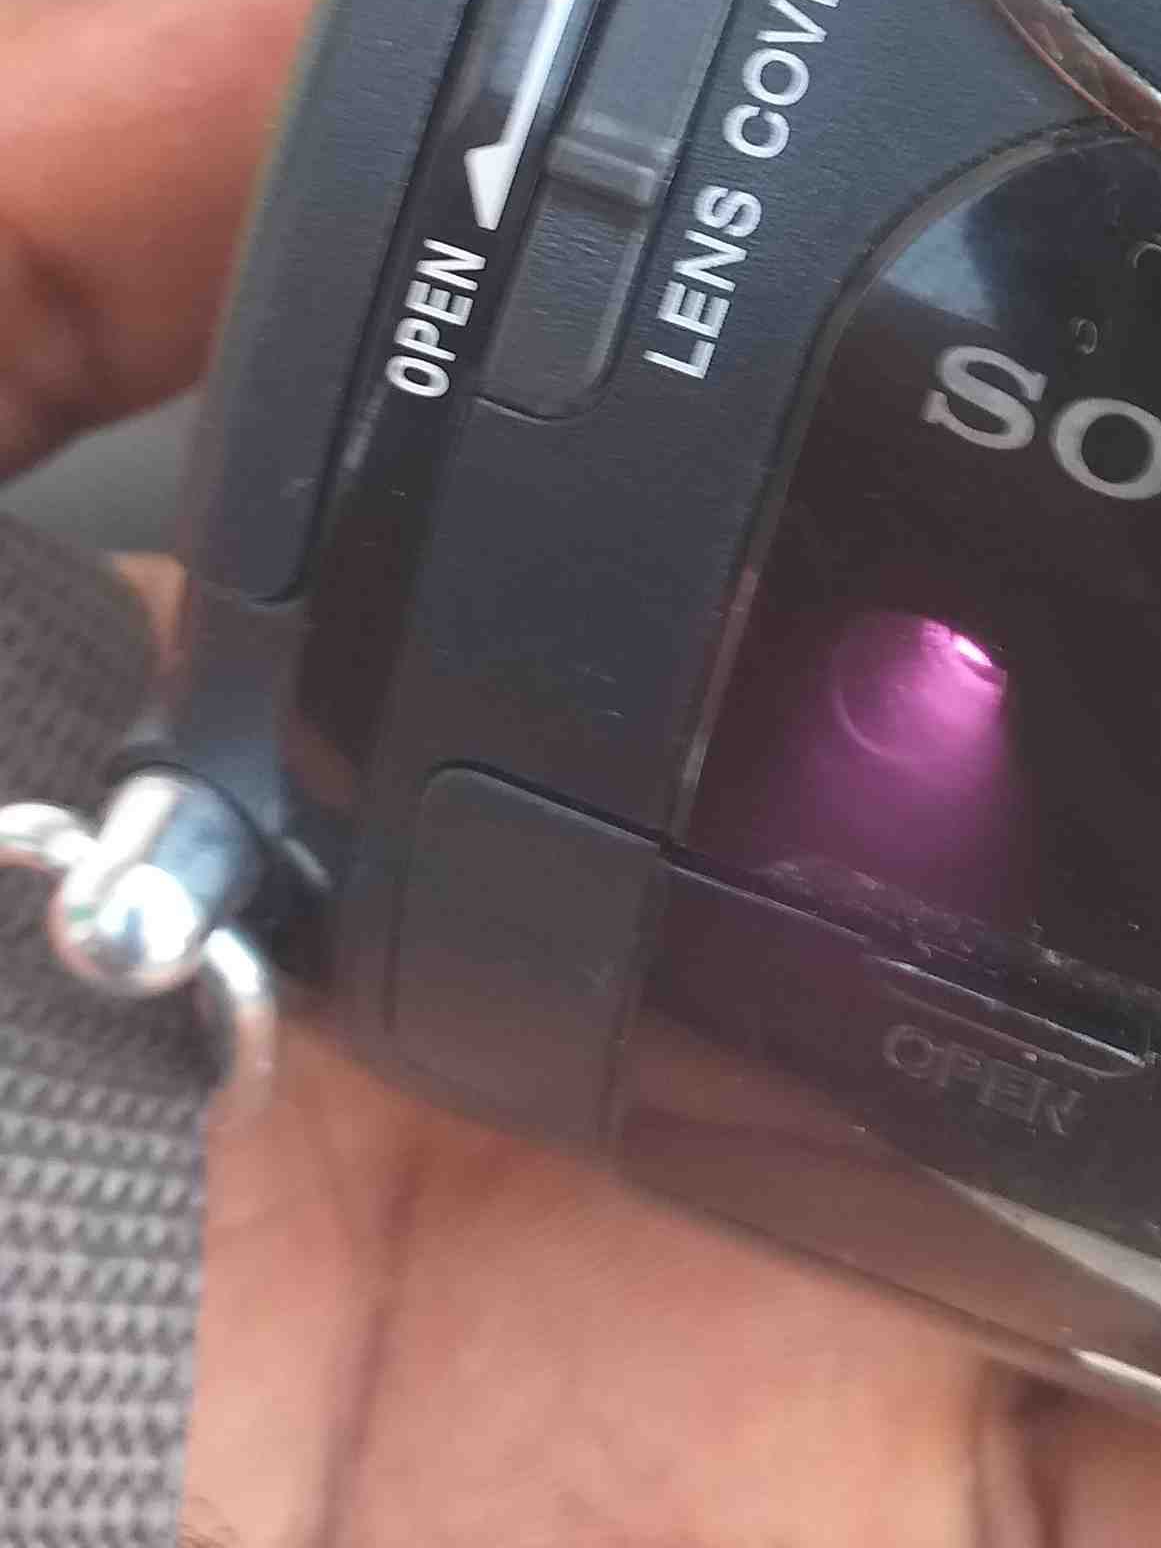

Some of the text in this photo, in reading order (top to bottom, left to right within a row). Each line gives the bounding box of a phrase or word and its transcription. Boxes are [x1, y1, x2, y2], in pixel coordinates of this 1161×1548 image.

[385, 238, 487, 398] OPEN
[643, 185, 763, 380] LENS
[881, 1022, 1086, 1138] OPEN
